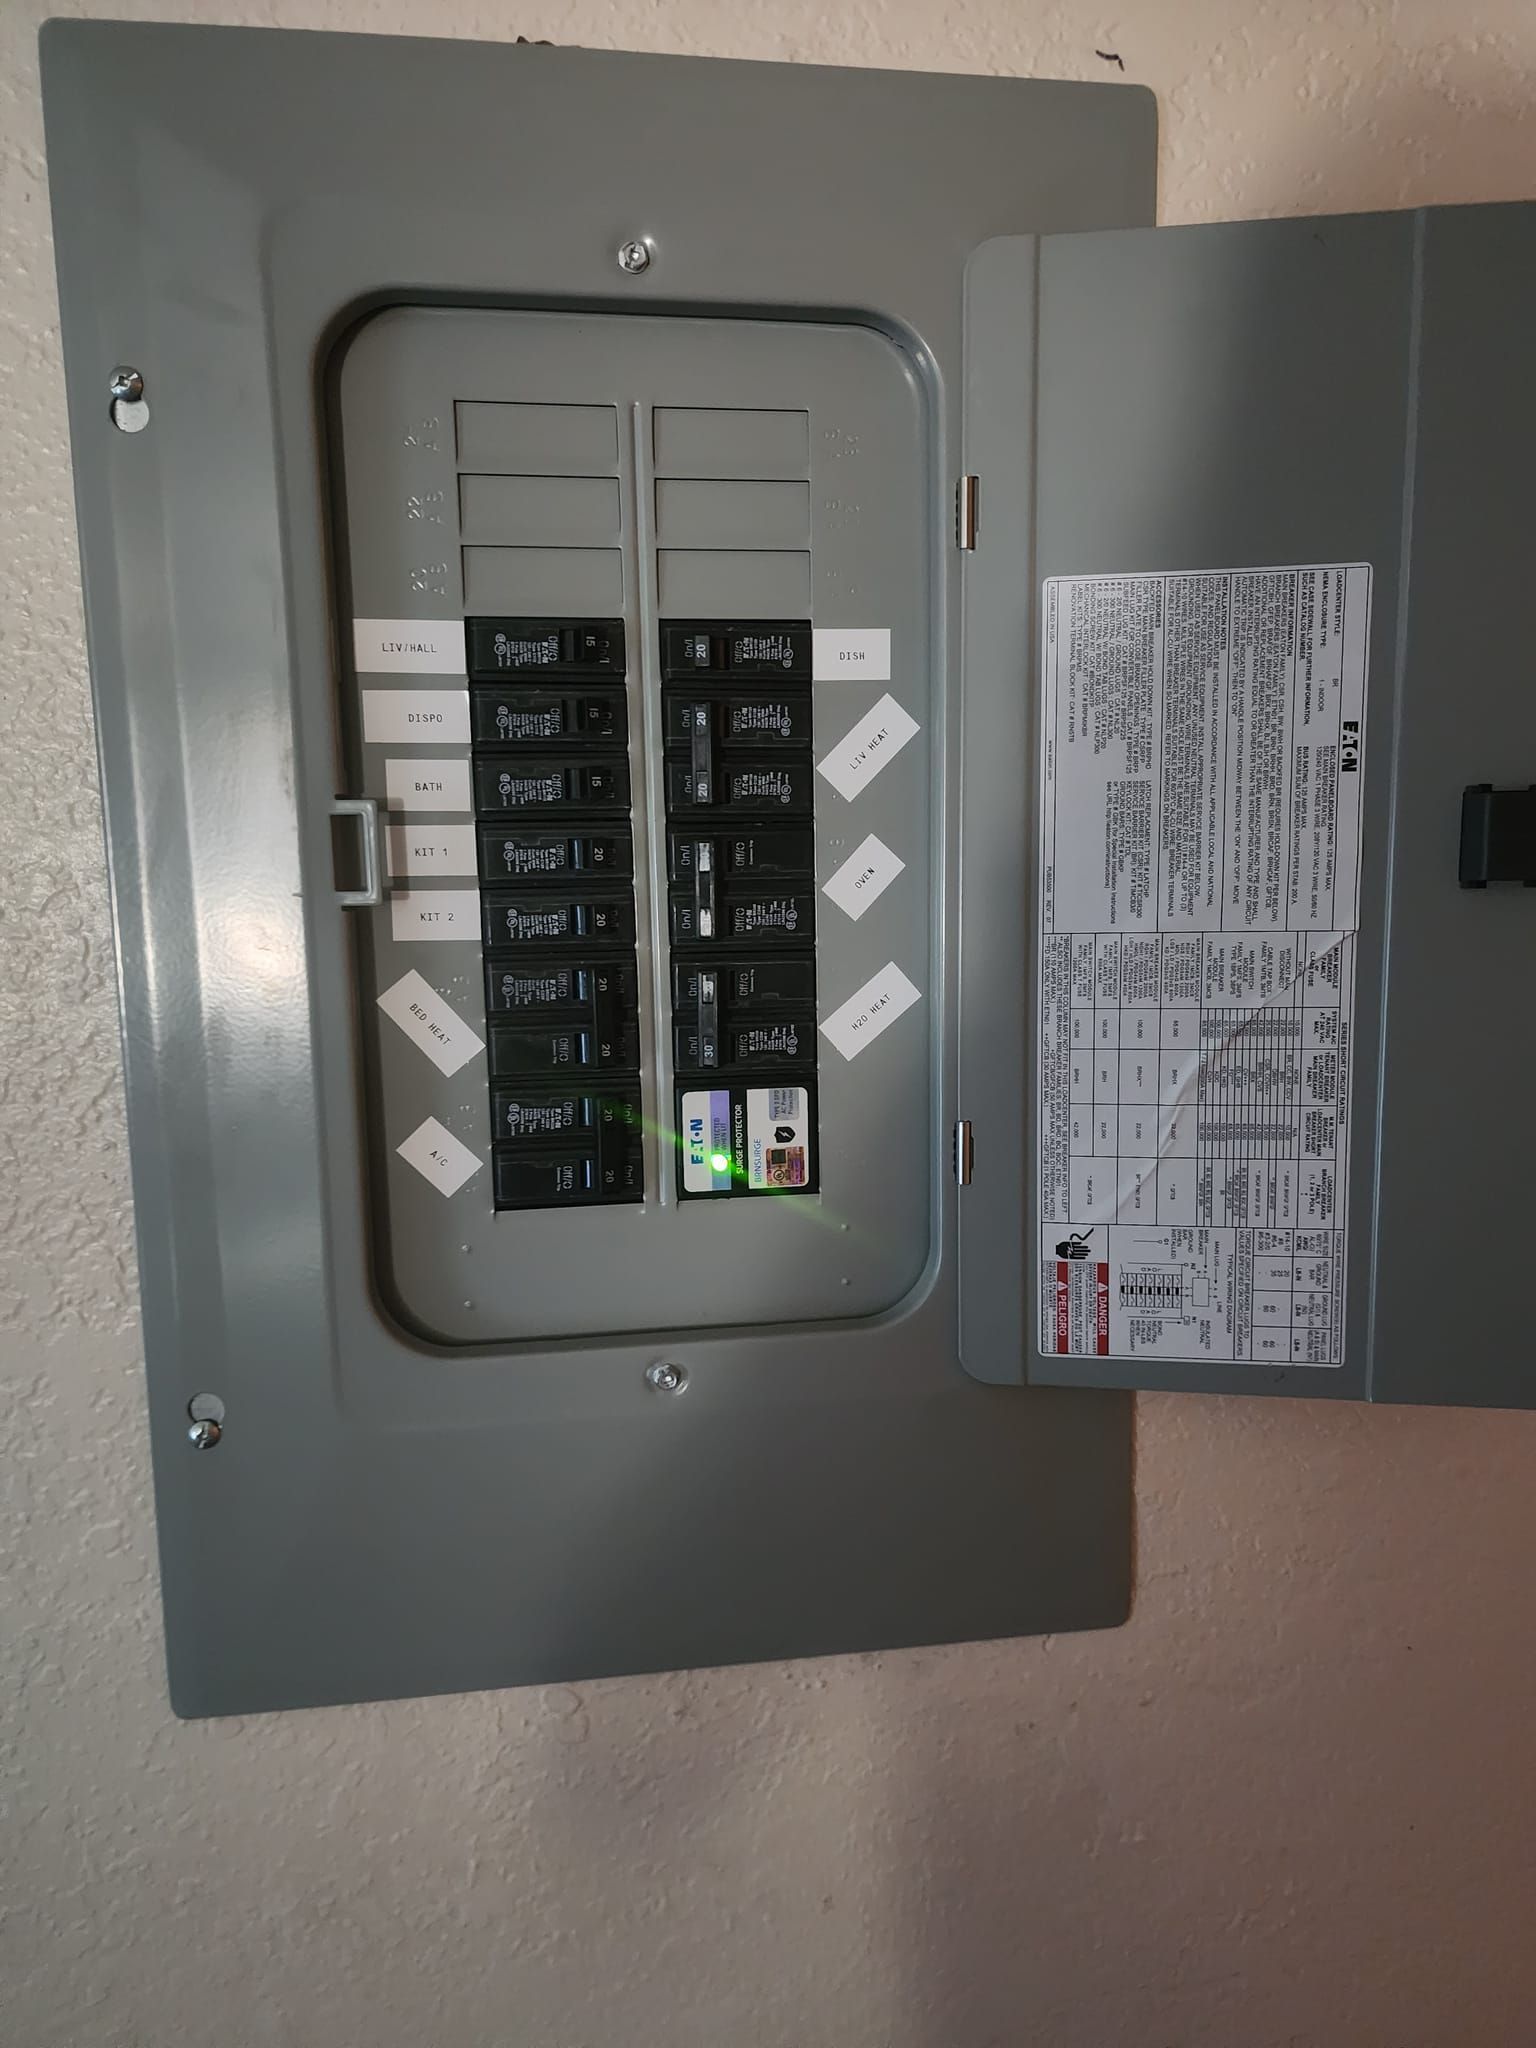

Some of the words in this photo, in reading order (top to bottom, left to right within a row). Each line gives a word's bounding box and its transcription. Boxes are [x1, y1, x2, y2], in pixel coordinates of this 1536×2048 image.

[1301, 591, 1307, 600] AS
[1334, 570, 1342, 613] LOADCENTER
[1306, 604, 1314, 636] SIDEWALL
[586, 636, 596, 647] 15
[382, 643, 437, 654] LIV/HALL
[696, 643, 706, 658] 20
[839, 652, 865, 661] DISH
[1213, 661, 1219, 670] BE
[1332, 677, 1338, 687] BR
[408, 713, 443, 723] DISPO
[589, 708, 599, 718] 15
[696, 711, 706, 726] 20
[849, 751, 868, 770] LIV
[867, 728, 890, 751] HEAT
[1341, 720, 1359, 772] EATON
[415, 782, 442, 791] BATH
[592, 776, 601, 787] 15
[698, 783, 708, 797] 20
[1294, 790, 1301, 799] OF
[1327, 779, 1335, 821] PANELBOARD
[1208, 796, 1216, 836] APPLICABLE
[415, 848, 436, 857] KIT
[443, 848, 448, 857] 1
[594, 848, 603, 861] 20
[854, 866, 875, 889] OVEN
[420, 913, 441, 921] KIT
[448, 913, 454, 921] 2
[596, 913, 606, 927] 20
[598, 978, 608, 991] 20
[869, 993, 891, 1014] HEAT
[408, 1003, 427, 1021] BED
[429, 1022, 451, 1046] HEAT
[601, 1044, 611, 1057] 20
[704, 1044, 713, 1057] 30
[603, 1108, 613, 1122] 20
[735, 1104, 743, 1148] PROTECTOR
[429, 1149, 449, 1167] A/C
[736, 1149, 744, 1174] SURGE
[754, 1138, 762, 1182] BRNSURGE
[605, 1170, 614, 1183] 20
[1238, 1287, 1243, 1297] ON
[1058, 1295, 1066, 1336] PELIGRO
[1098, 1296, 1106, 1335] DANGER
[1243, 1330, 1248, 1338] TO
